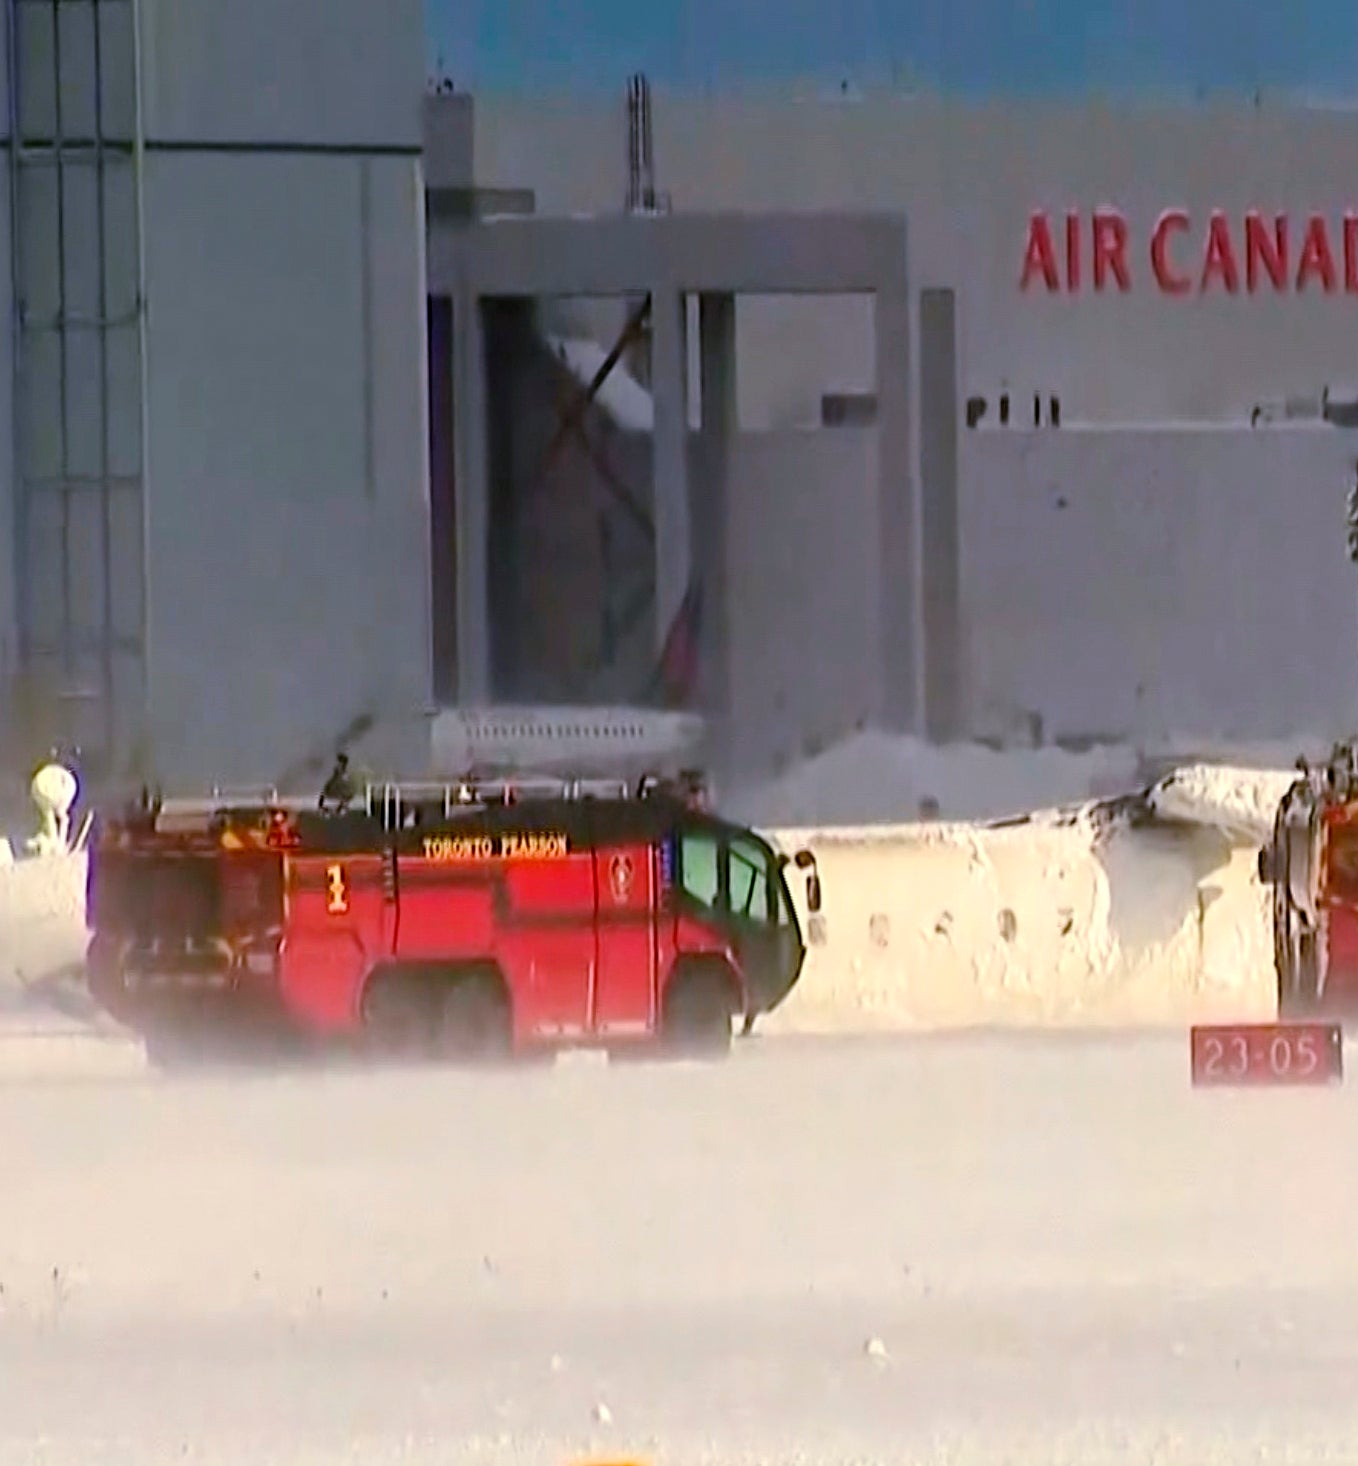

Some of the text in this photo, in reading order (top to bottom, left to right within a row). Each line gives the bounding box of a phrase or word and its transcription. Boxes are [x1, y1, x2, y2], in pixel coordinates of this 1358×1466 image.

[1019, 207, 1130, 295] AIR
[421, 834, 569, 860] TORONTO PEARSON
[326, 862, 349, 915] 1
[1204, 1036, 1319, 1076] 23-05
